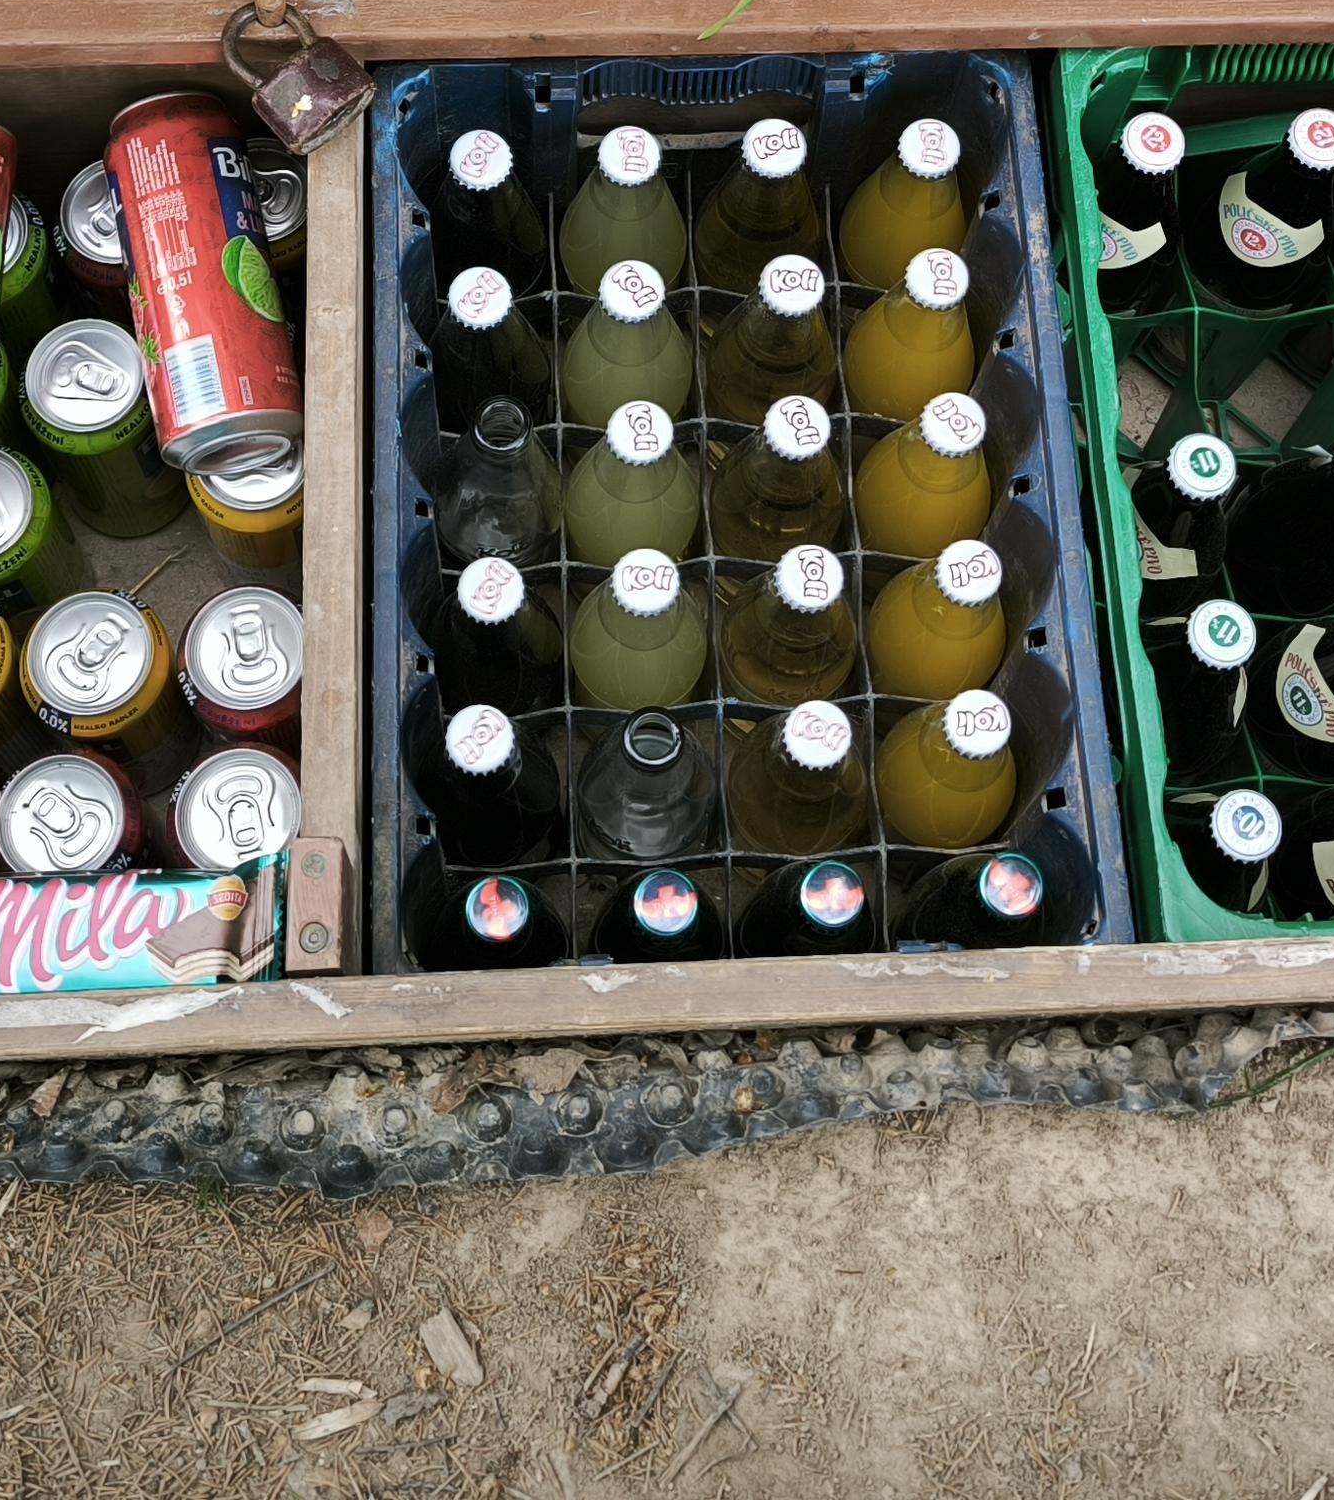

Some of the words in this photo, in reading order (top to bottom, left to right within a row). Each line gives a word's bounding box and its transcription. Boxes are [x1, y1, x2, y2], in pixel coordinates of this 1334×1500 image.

[1278, 234, 1299, 258] PIVO
[115, 403, 150, 440] NEALKO
[38, 706, 69, 733] 0.0%
